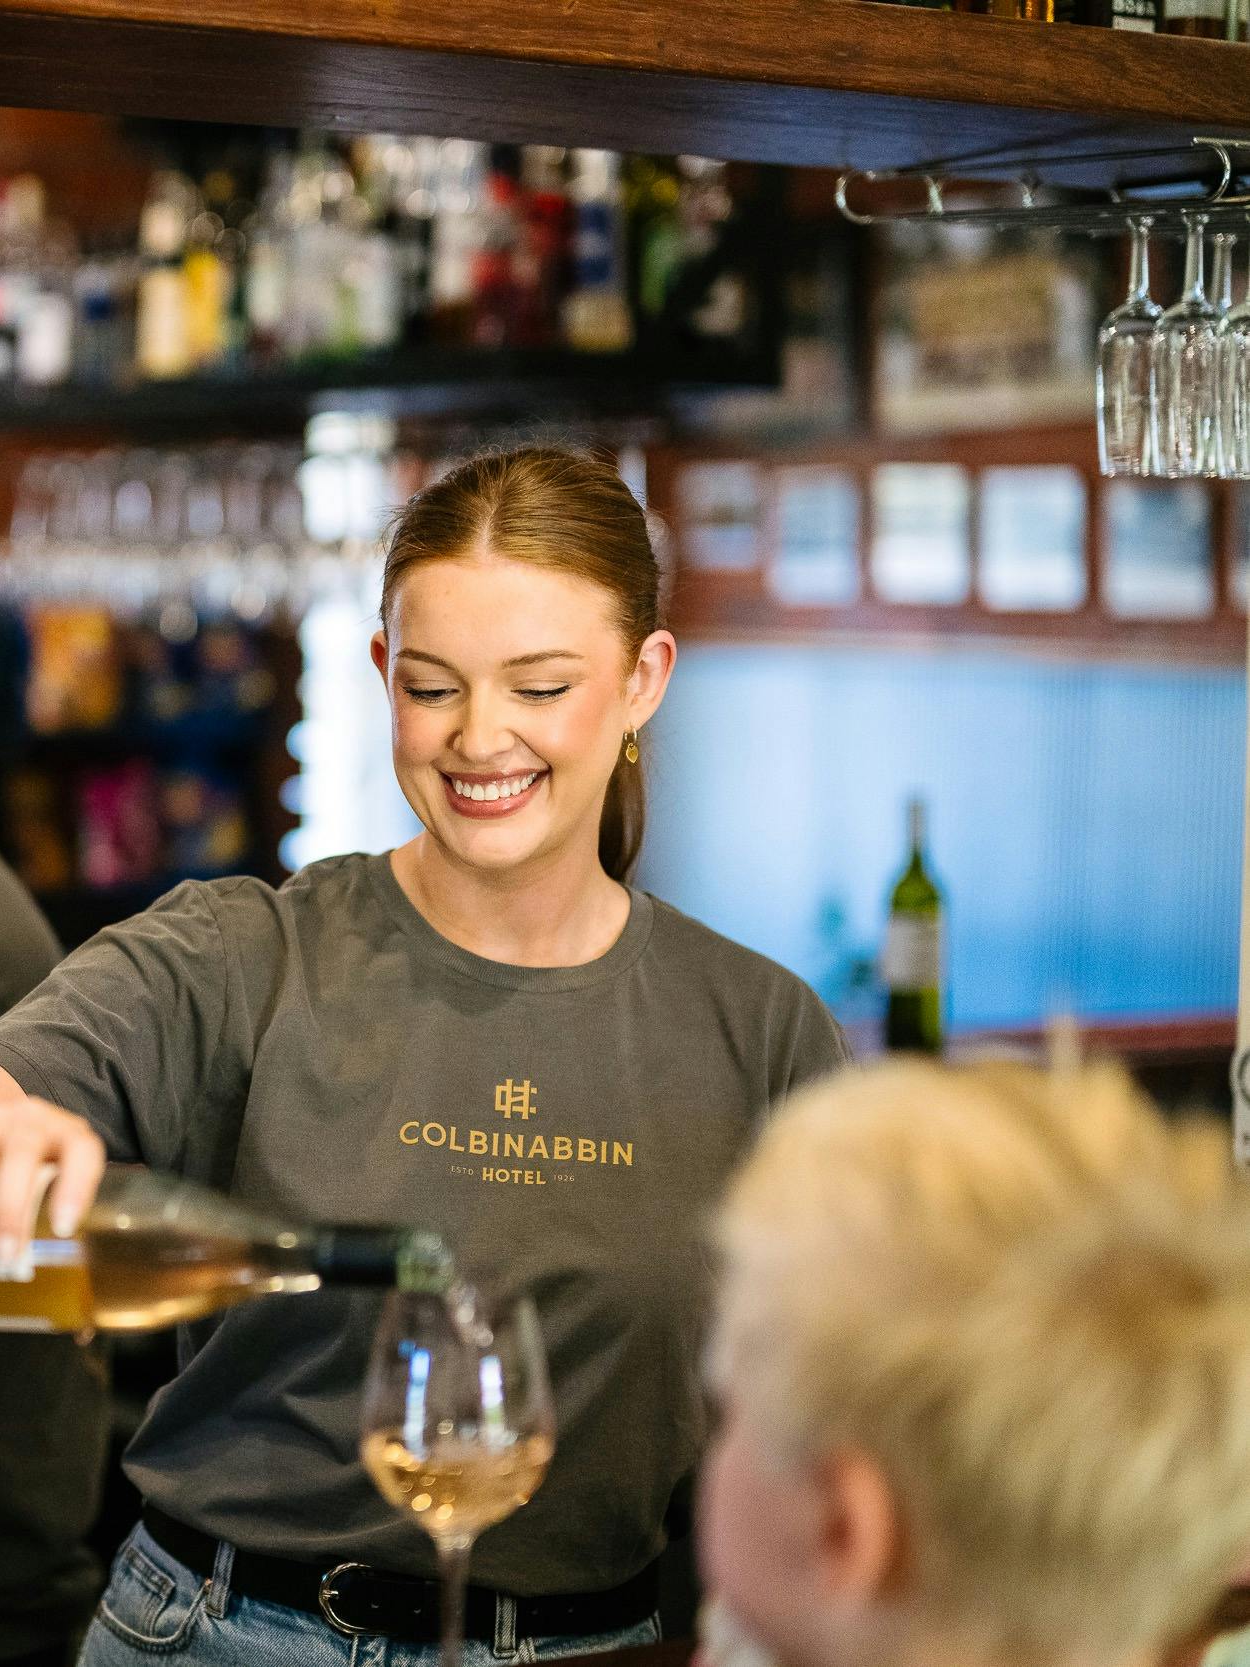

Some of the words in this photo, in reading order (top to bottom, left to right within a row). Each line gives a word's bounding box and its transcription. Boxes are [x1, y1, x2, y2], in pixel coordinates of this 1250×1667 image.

[399, 1121, 633, 1166] COLBINABBIN
[450, 1165, 474, 1176] ESTD
[482, 1167, 546, 1185] HOTEL
[553, 1173, 575, 1182] 1926
